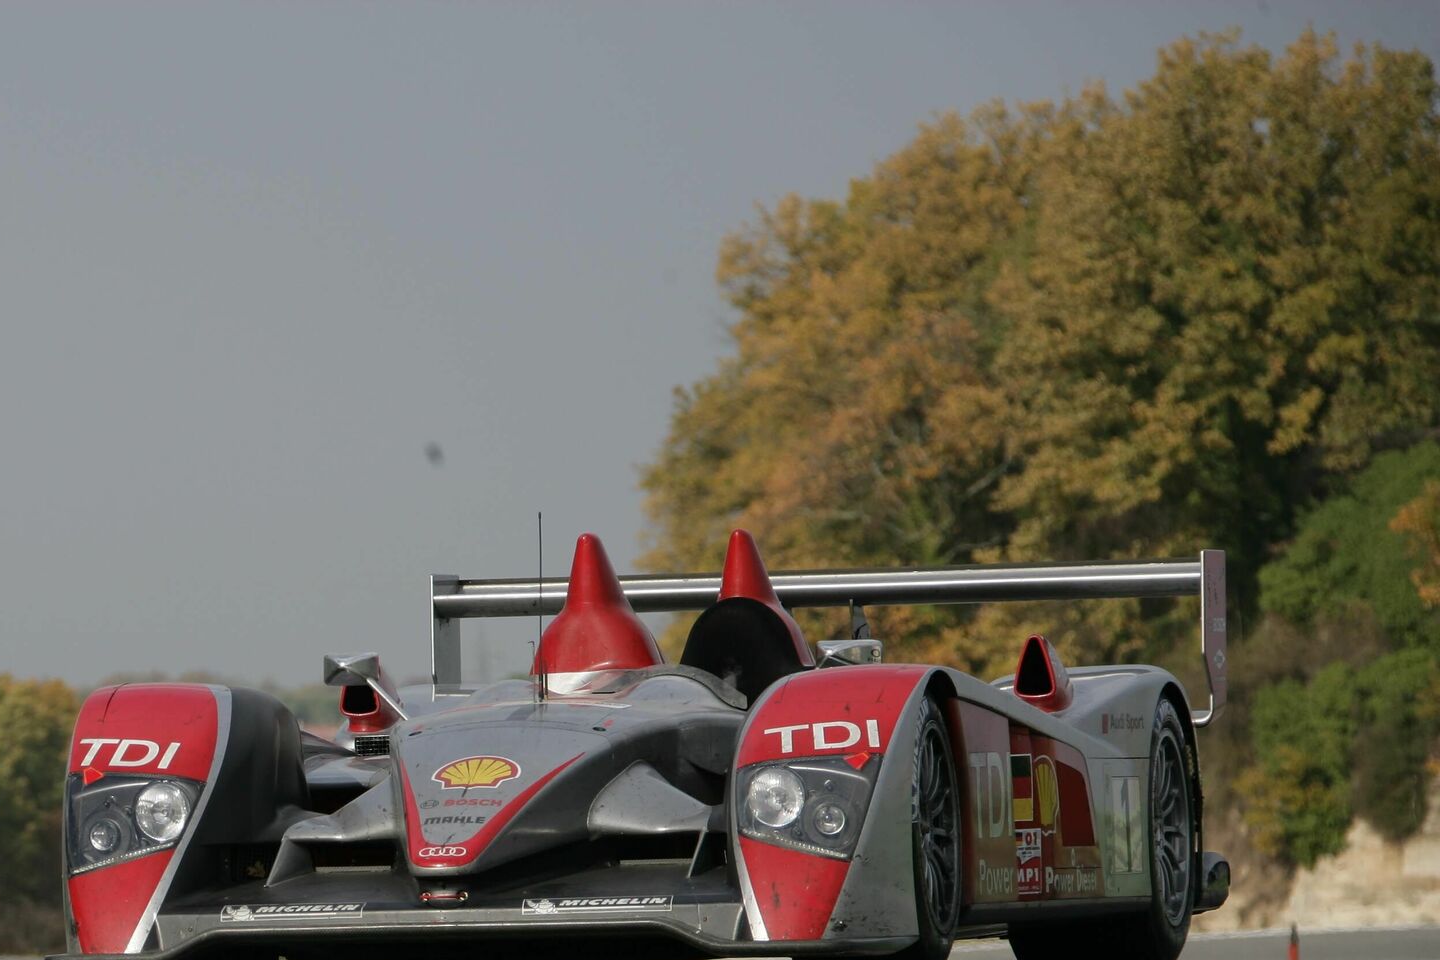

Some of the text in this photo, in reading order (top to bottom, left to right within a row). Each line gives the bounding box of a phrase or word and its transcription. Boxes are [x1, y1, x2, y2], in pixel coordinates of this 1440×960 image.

[763, 719, 880, 754] TDI
[79, 738, 181, 769] TDI
[443, 798, 503, 807] BOSCH
[969, 751, 1014, 839] TDI
[423, 816, 487, 826] MAHLE
[978, 858, 1015, 896] Power
[255, 904, 360, 913] MICHELIN
[559, 897, 668, 906] MICHELIN
